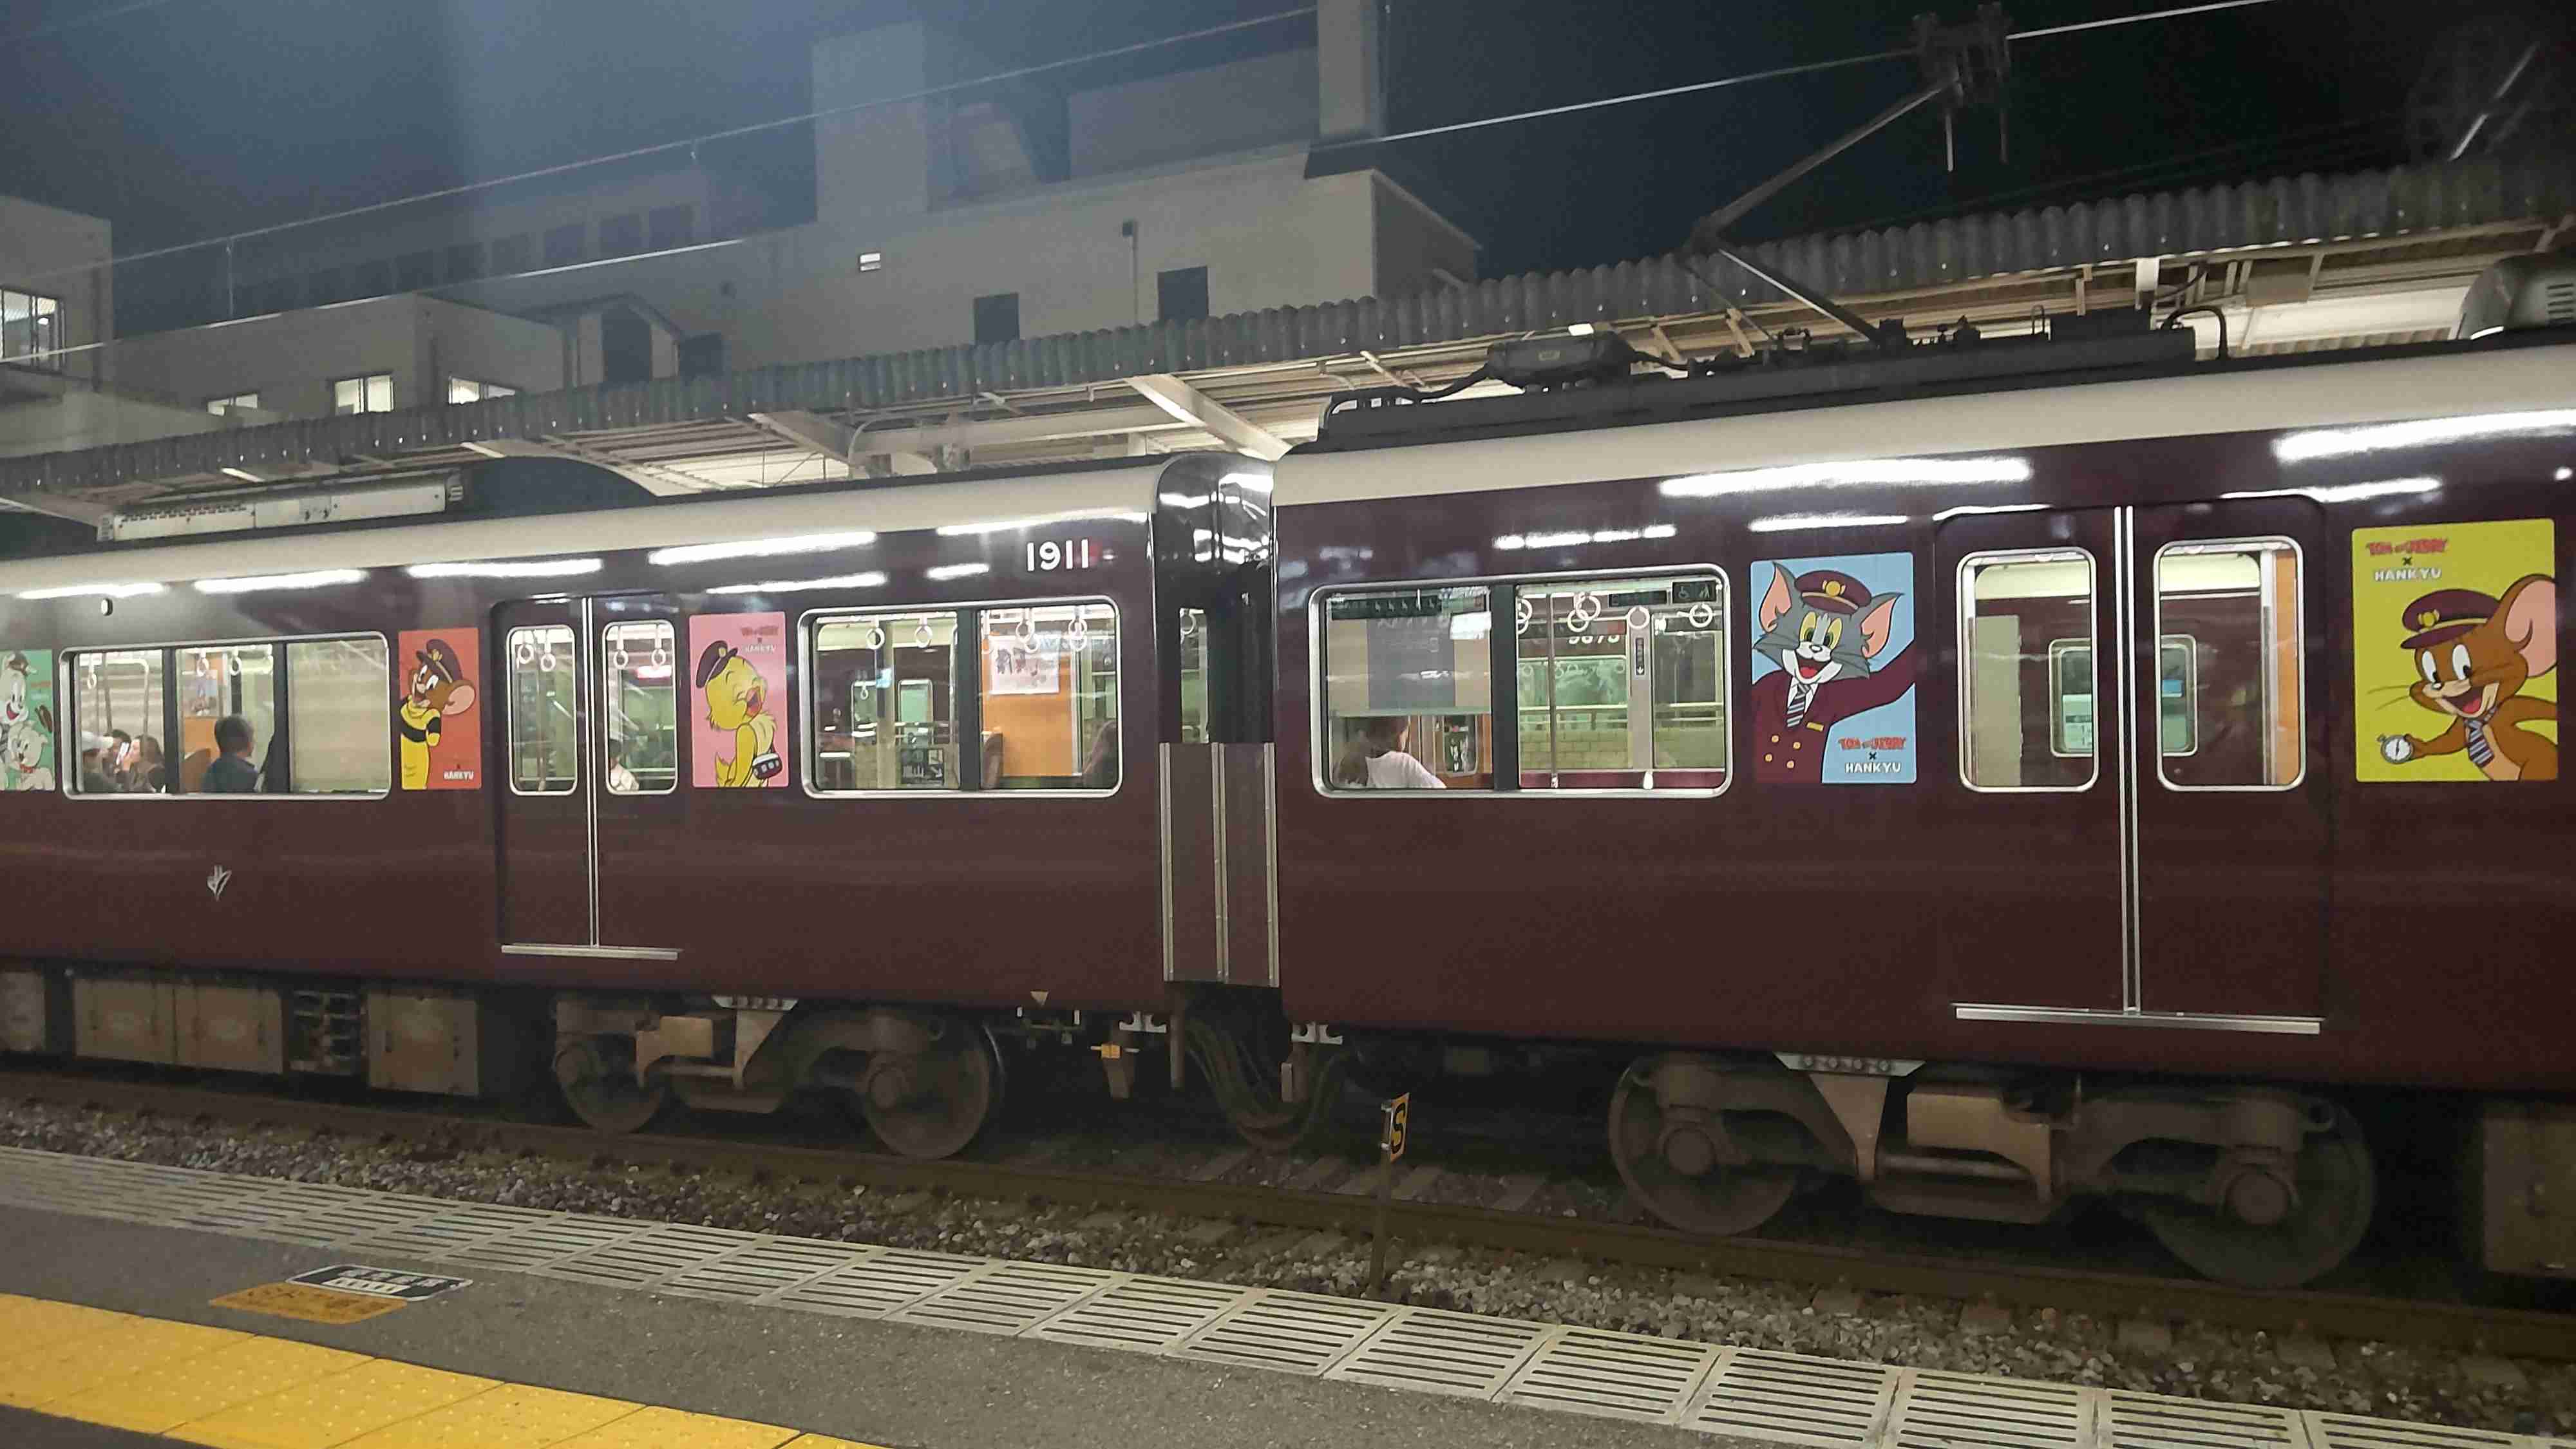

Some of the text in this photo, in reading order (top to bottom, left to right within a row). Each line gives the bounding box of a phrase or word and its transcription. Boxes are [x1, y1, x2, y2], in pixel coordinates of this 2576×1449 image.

[1027, 538, 1088, 572] 1911
[2374, 567, 2443, 582] HANKYU
[1845, 762, 1902, 773] HANKYU
[1391, 1101, 1406, 1155] S
